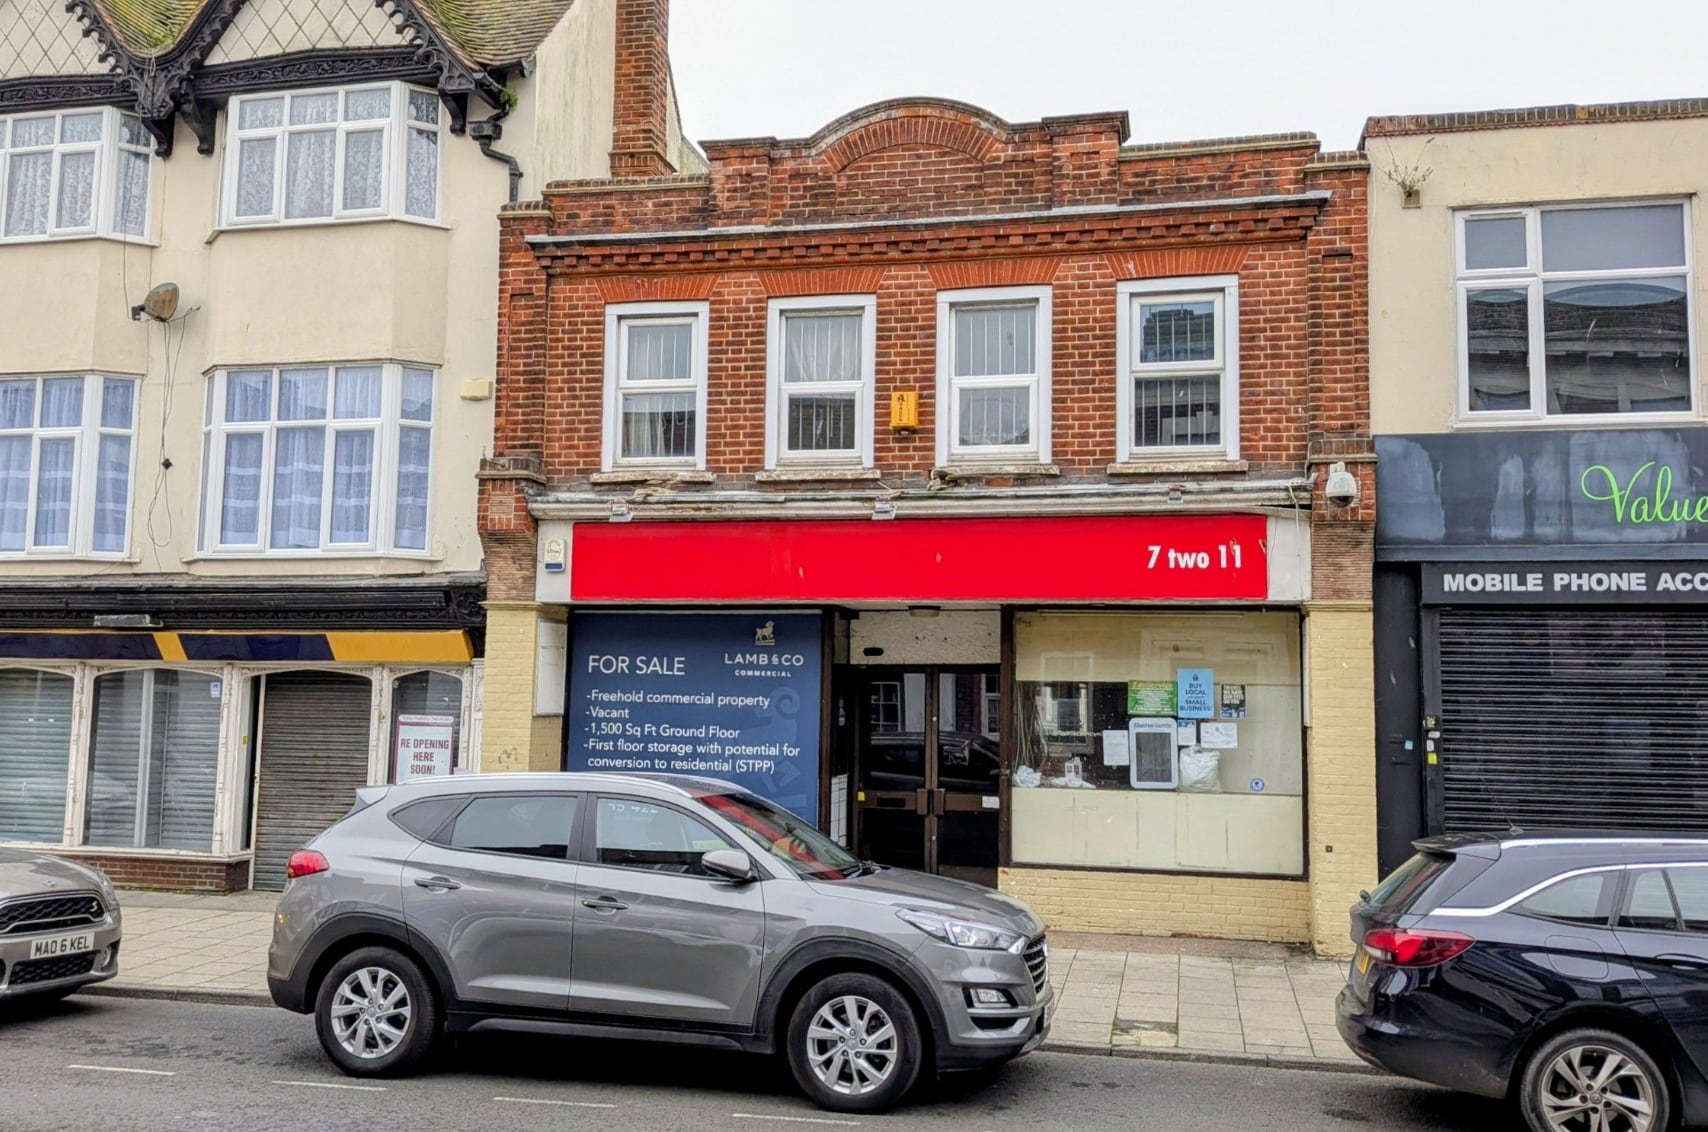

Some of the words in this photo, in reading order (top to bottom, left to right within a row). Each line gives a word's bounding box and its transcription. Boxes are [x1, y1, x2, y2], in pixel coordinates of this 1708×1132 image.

[1147, 545, 1161, 569] 7
[1167, 547, 1210, 569] two
[1218, 545, 1242, 569] 11
[1443, 573, 1543, 592] MOBILE
[1553, 572, 1647, 592] PHONE
[588, 655, 629, 675] FOR
[635, 656, 686, 676] SALE
[734, 669, 792, 677] COMMERCIAL
[586, 689, 644, 703] -Freehold
[647, 691, 714, 704] commercial
[718, 694, 770, 709] property
[585, 706, 630, 719] -Vacant
[584, 723, 623, 737] -1,500
[625, 724, 641, 739] Sq
[644, 724, 657, 736] Ft
[660, 724, 706, 738] Ground
[709, 726, 741, 738] Floor
[400, 738, 411, 748] RE
[413, 738, 449, 749] OPENING
[583, 739, 614, 752] -First
[617, 739, 645, 753] floor
[647, 742, 693, 756] storage
[696, 742, 722, 754] with
[725, 744, 779, 758] potential
[782, 744, 801, 756] for
[413, 752, 434, 762] HERE
[587, 756, 651, 769] conversion
[654, 757, 667, 769] to
[670, 757, 732, 772] residential
[735, 759, 775, 774] (STPP)
[410, 764, 436, 774] SOON!
